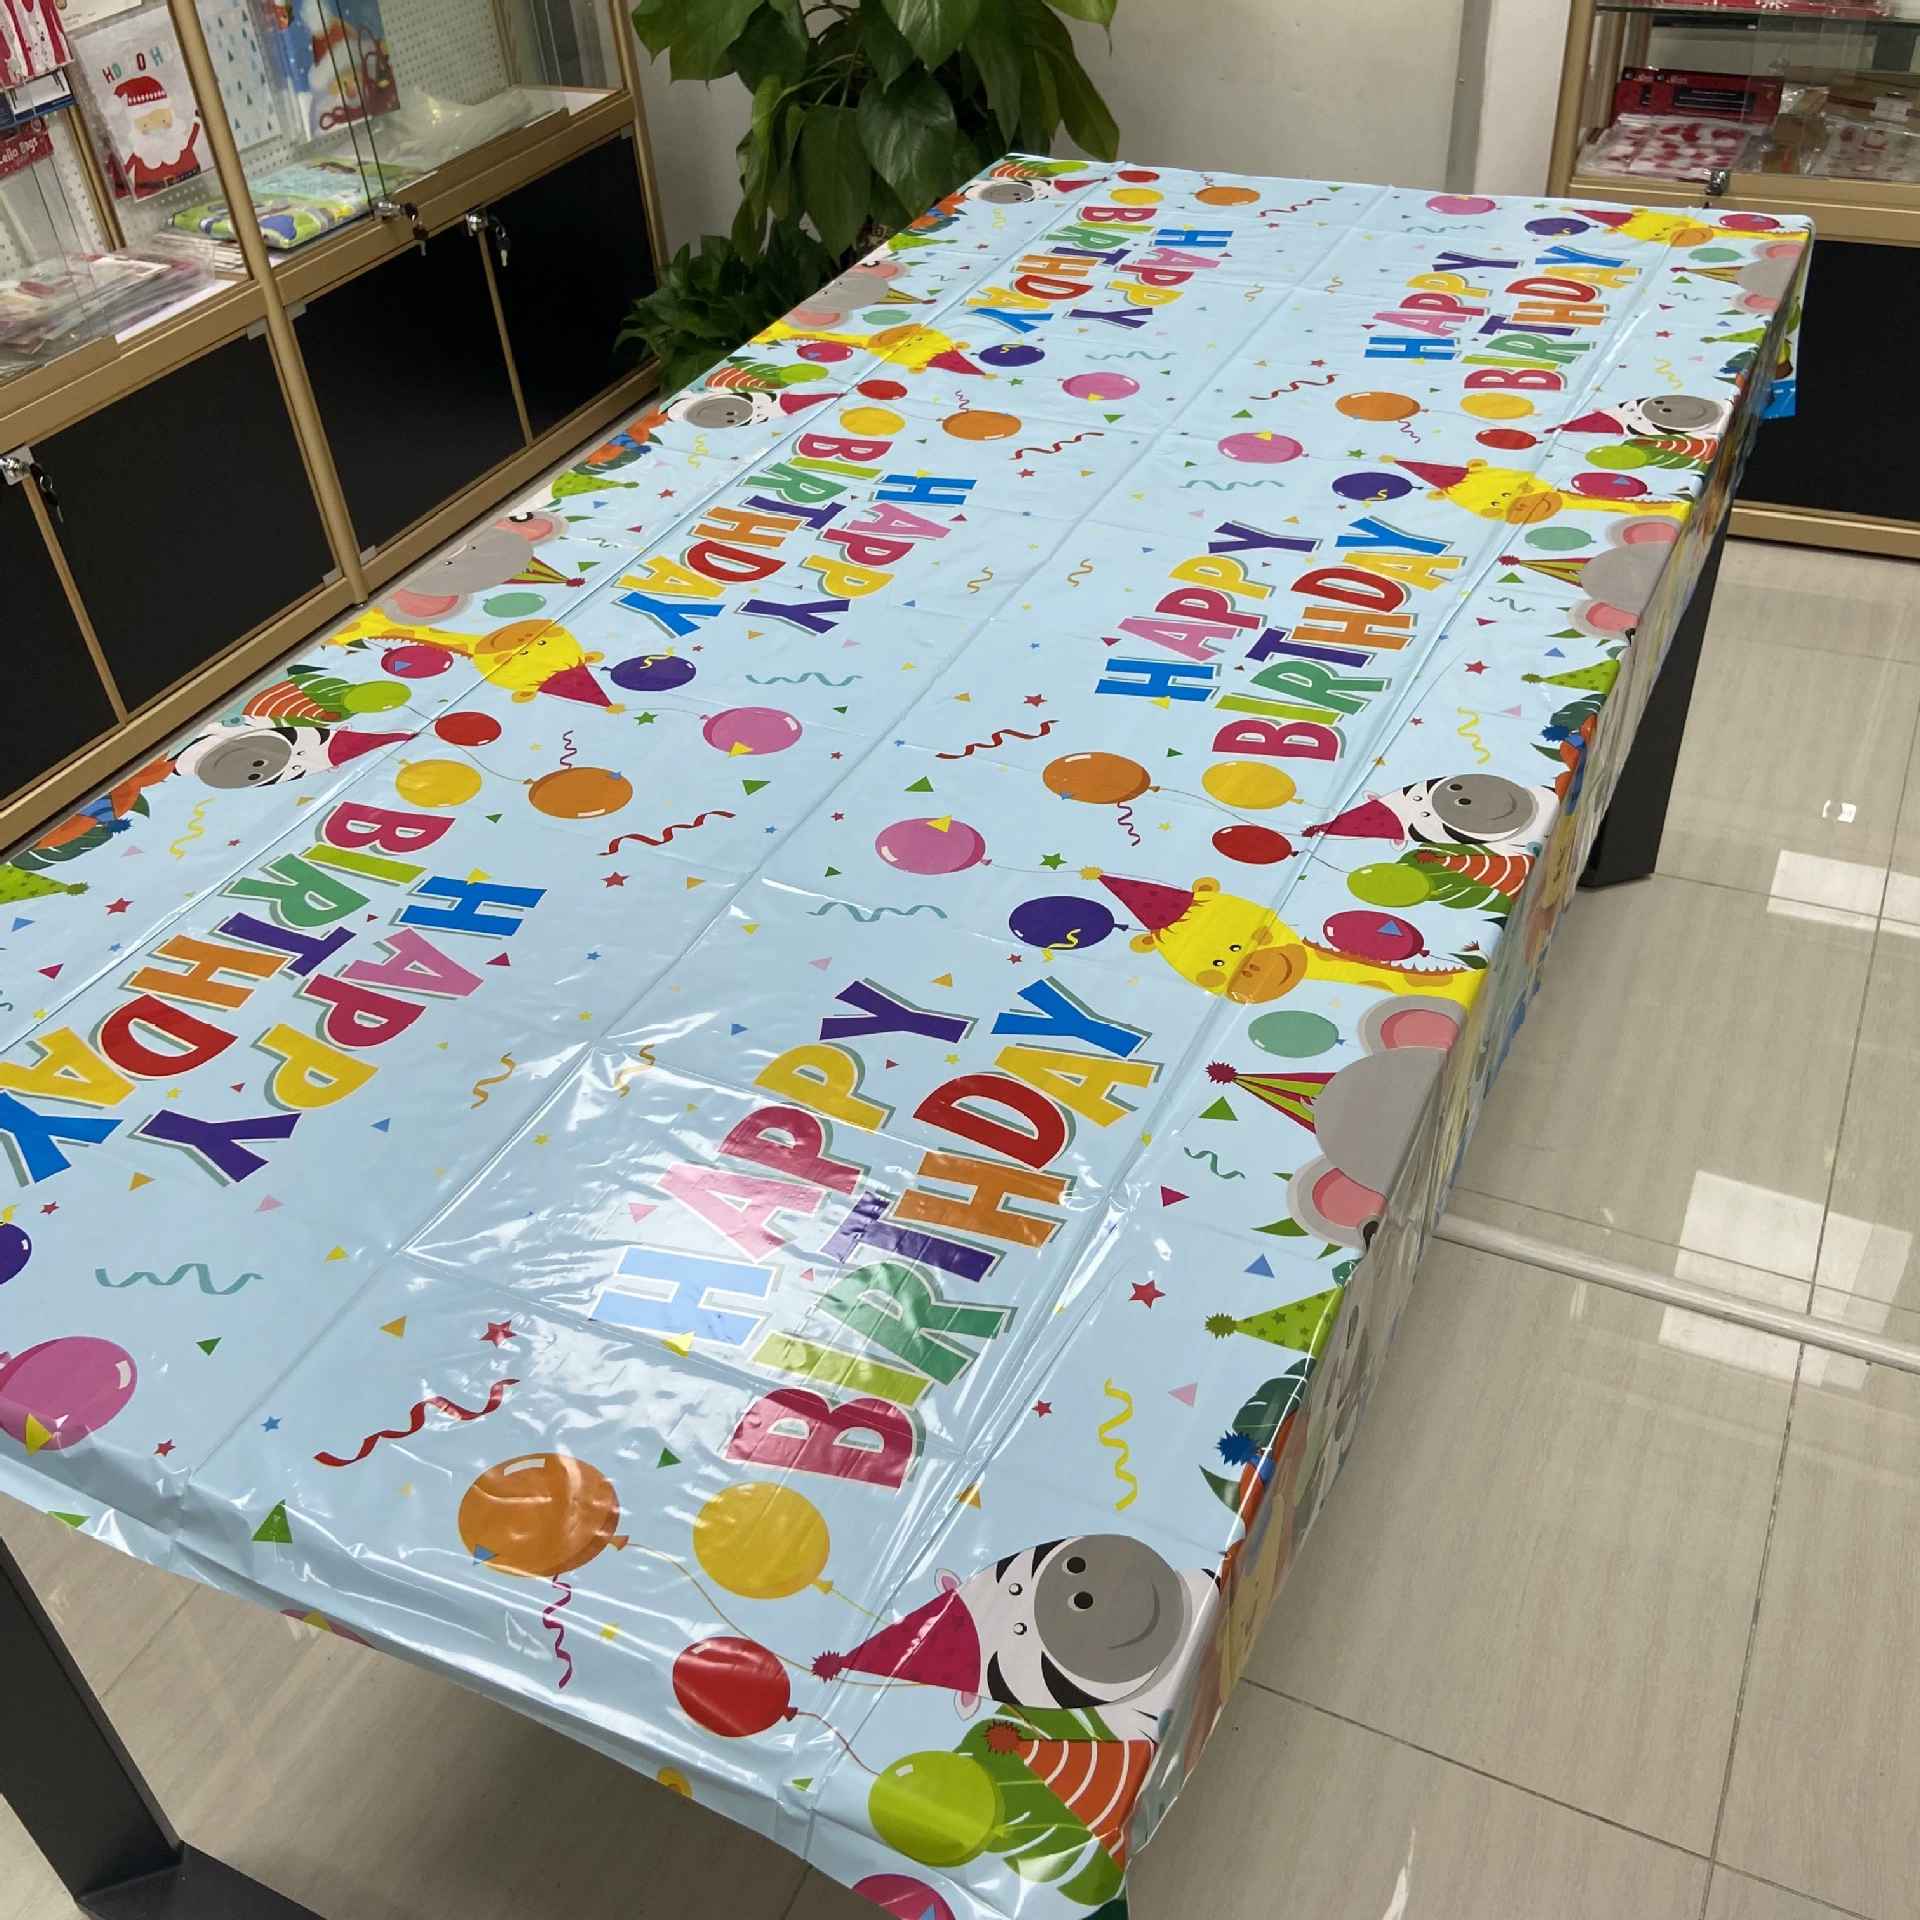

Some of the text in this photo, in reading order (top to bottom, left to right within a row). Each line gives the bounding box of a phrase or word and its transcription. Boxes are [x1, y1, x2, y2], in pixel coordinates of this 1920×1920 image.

[963, 206, 1158, 334] BIRTHDAY
[1063, 229, 1235, 330] HAPPY
[1364, 251, 1524, 361] HAPPY
[1460, 245, 1642, 391] BIRTHDAY
[611, 432, 894, 638] BIRTHDAY
[735, 474, 978, 636] HAPPY
[1094, 520, 1324, 702] HAPPY
[1211, 515, 1468, 762] BIRTHDAY
[0, 801, 457, 1188] BIRTHDAY
[128, 874, 548, 1187] HAPPY
[587, 976, 979, 1348] HAPPY
[723, 975, 1165, 1493] BIRTHDAY
